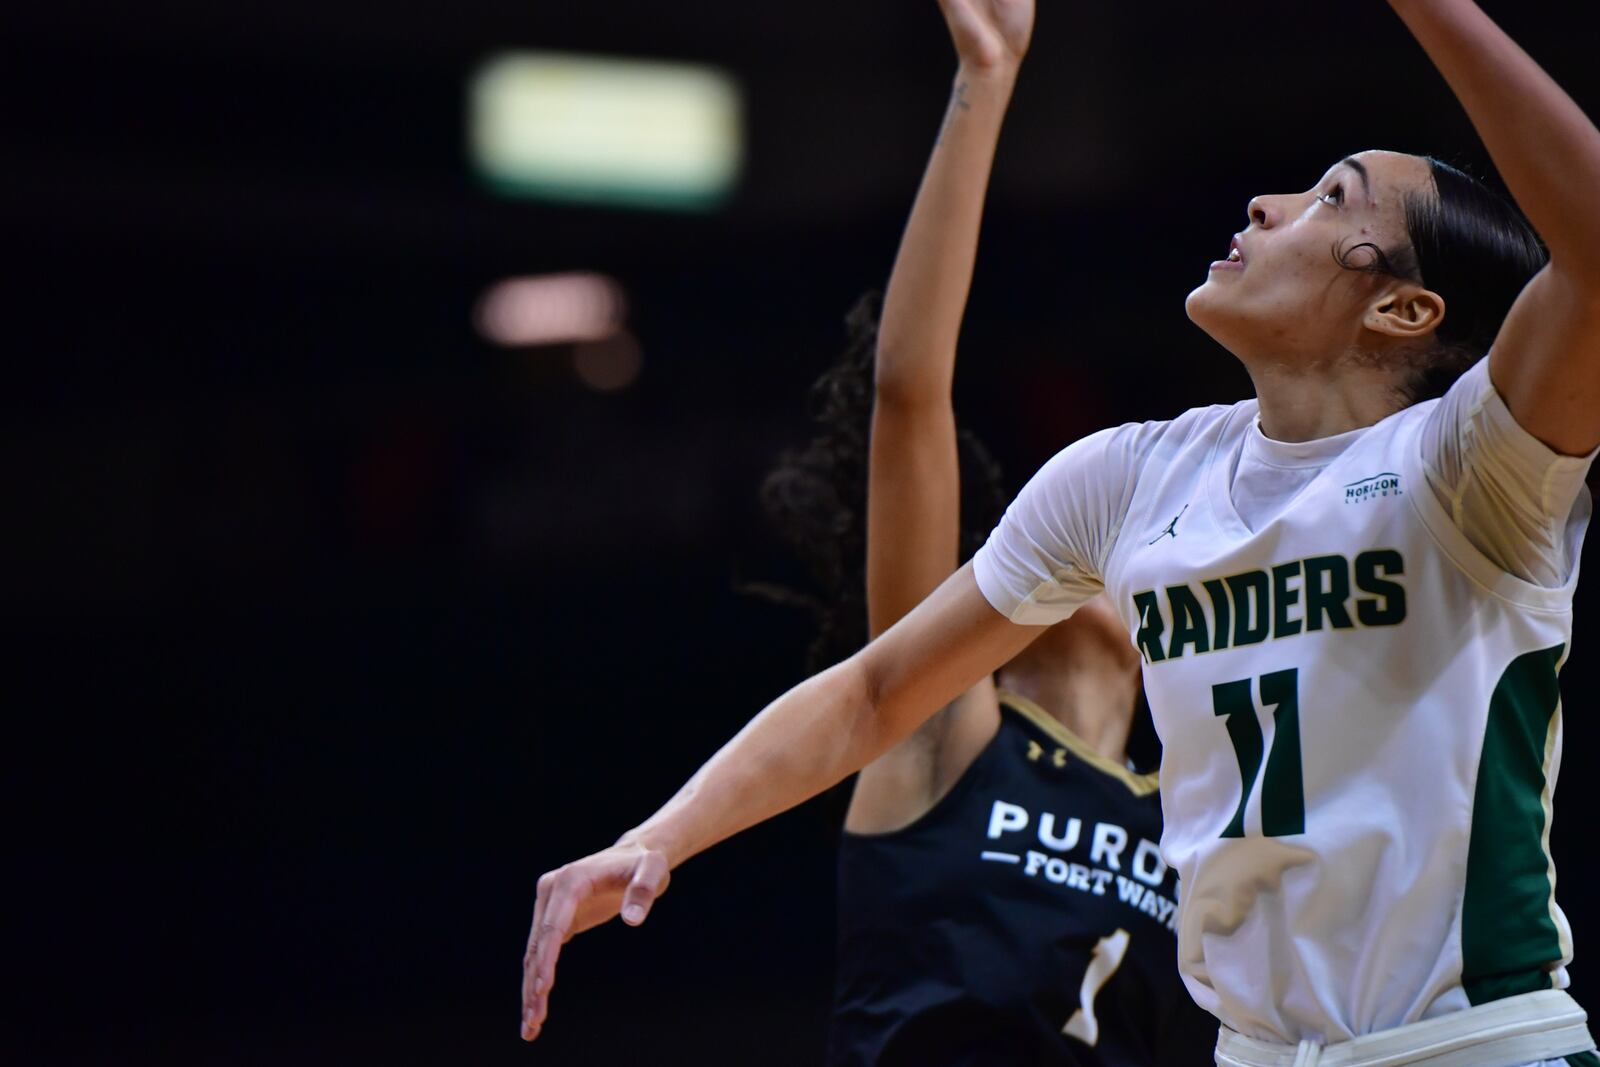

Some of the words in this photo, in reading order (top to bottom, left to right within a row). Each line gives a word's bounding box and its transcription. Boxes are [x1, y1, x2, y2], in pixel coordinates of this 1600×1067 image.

[1346, 478, 1399, 497] HORIZON
[1132, 549, 1406, 664] RAIDERS
[1211, 667, 1305, 838] 11
[987, 800, 1180, 900] PURD
[1024, 850, 1113, 896] FORT
[1062, 928, 1131, 1047] 1
